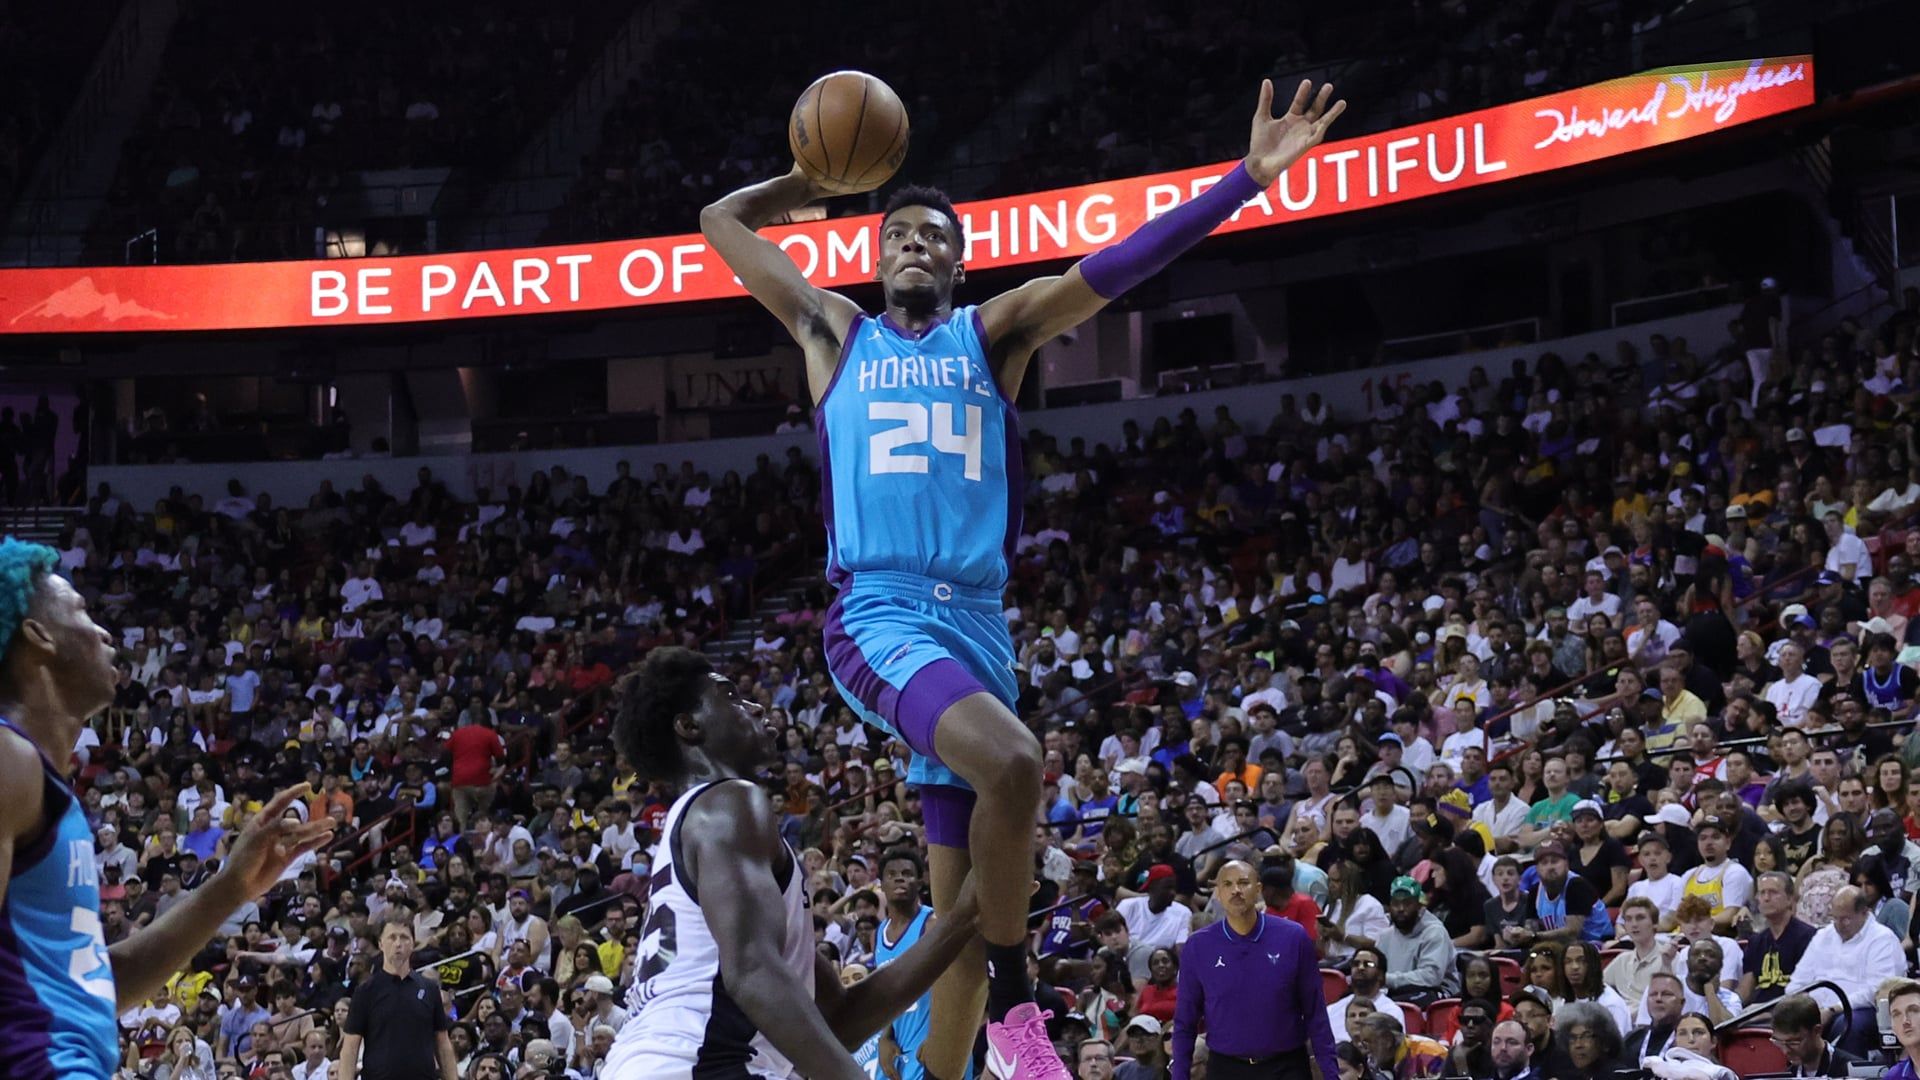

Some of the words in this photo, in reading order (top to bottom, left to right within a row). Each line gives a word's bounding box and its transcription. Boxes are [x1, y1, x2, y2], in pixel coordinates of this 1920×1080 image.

[1535, 82, 1668, 149] Howard
[311, 267, 392, 317] BE
[421, 254, 592, 312] PART
[618, 243, 706, 297] OF
[733, 193, 1118, 287] OMHING
[1146, 122, 1507, 222] BUTIFUL
[869, 402, 982, 482] 24
